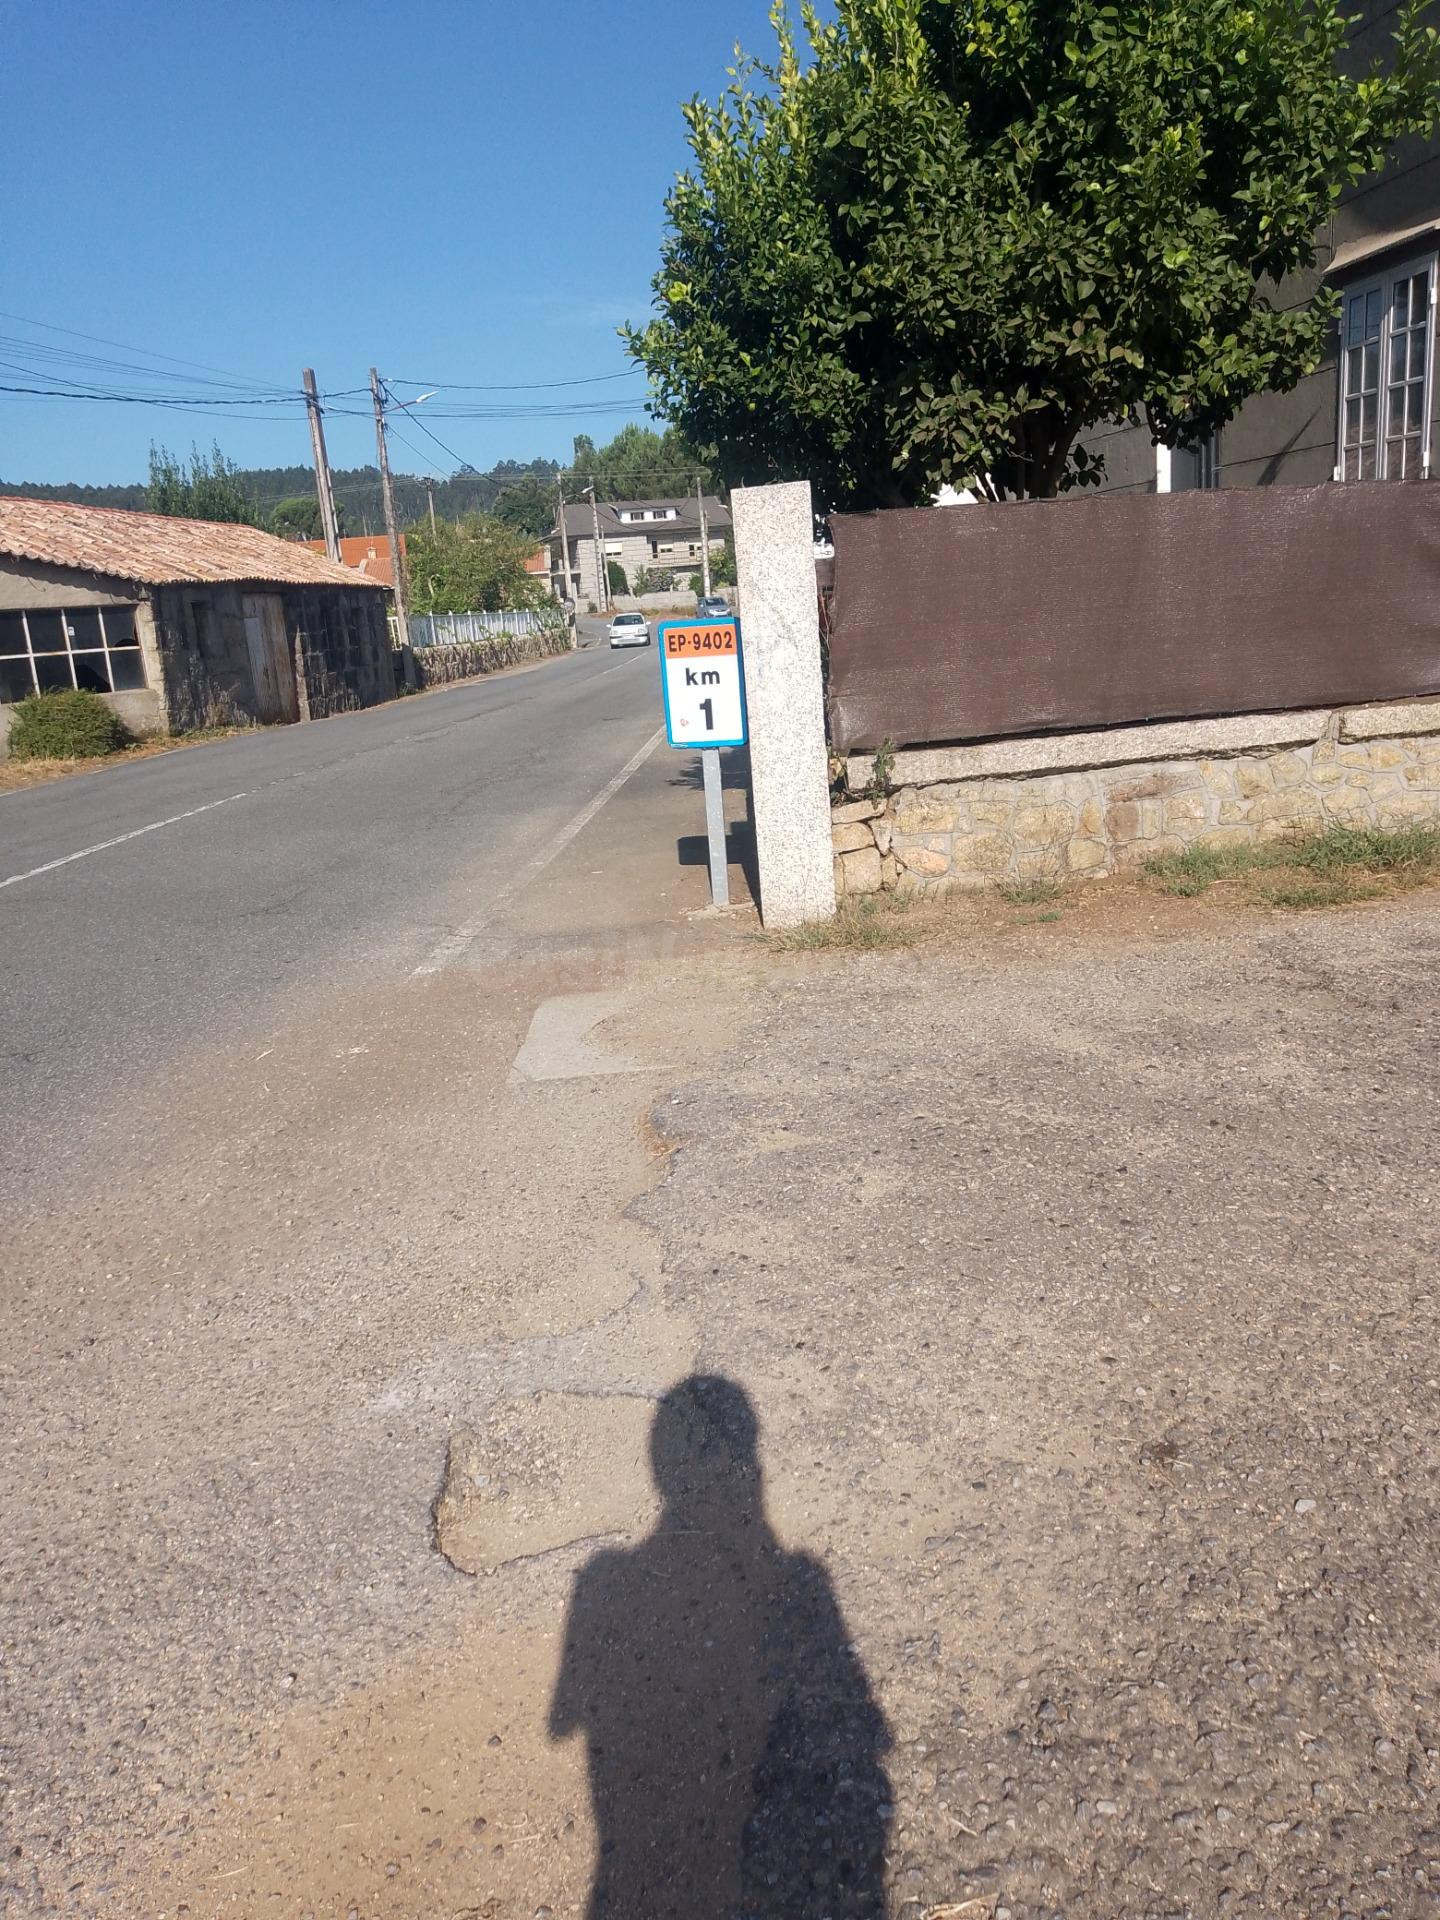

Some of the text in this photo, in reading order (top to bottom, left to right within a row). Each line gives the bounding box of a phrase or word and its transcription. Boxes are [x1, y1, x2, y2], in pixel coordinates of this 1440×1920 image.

[668, 631, 733, 653] EP-9402
[685, 667, 720, 686] km
[699, 698, 714, 731] 1
